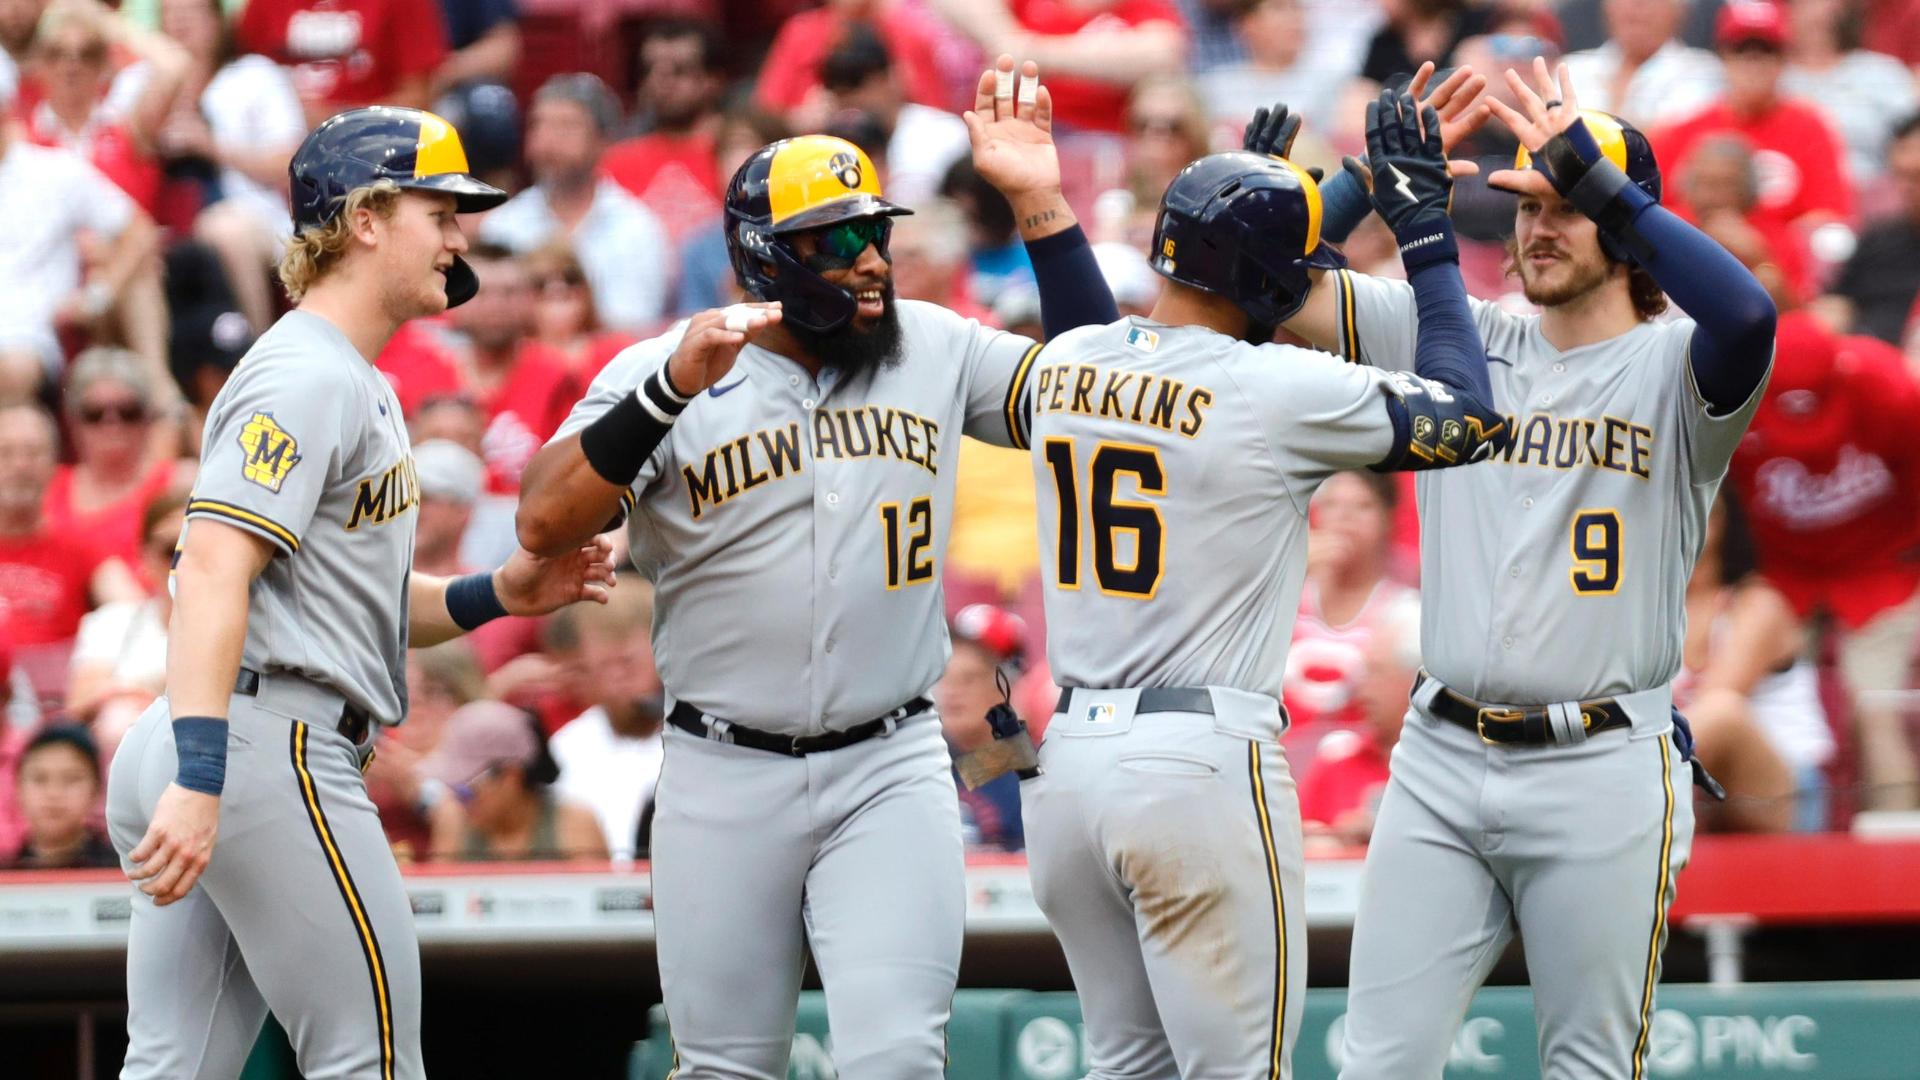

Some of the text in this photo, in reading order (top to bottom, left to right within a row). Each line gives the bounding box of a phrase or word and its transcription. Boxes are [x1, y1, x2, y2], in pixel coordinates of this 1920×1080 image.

[1163, 237, 1176, 257] 16
[1034, 364, 1215, 440] PERKINS
[250, 431, 290, 474] M
[681, 405, 940, 522] MILWAUKEE
[879, 496, 937, 592] 12
[1043, 435, 1167, 601] 16
[1569, 508, 1625, 597] 9
[1701, 1014, 1820, 1072] PNC
